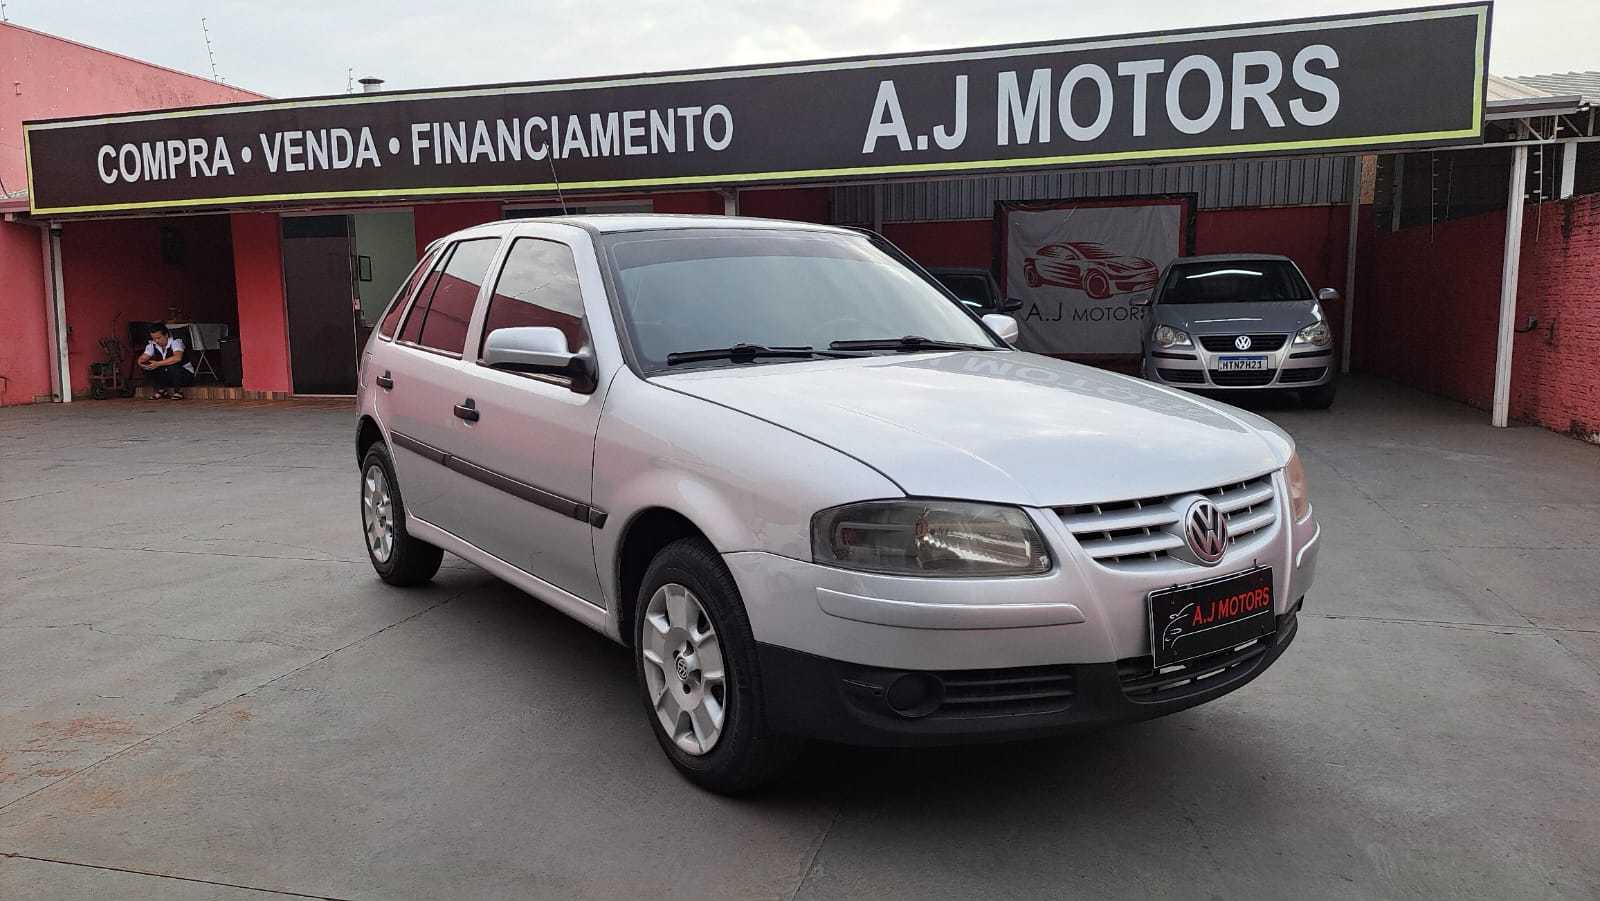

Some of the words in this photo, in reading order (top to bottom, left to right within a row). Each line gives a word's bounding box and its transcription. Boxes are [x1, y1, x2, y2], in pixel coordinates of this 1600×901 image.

[862, 75, 968, 153] A.J
[997, 45, 1340, 146] MOTORS
[97, 137, 234, 183] COMPRA
[259, 129, 380, 172] VENDA
[412, 105, 734, 163] FINANCIAMENTO
[1026, 303, 1062, 321] A.J
[1193, 602, 1216, 626] A.J
[1218, 586, 1270, 618] MOTORS
